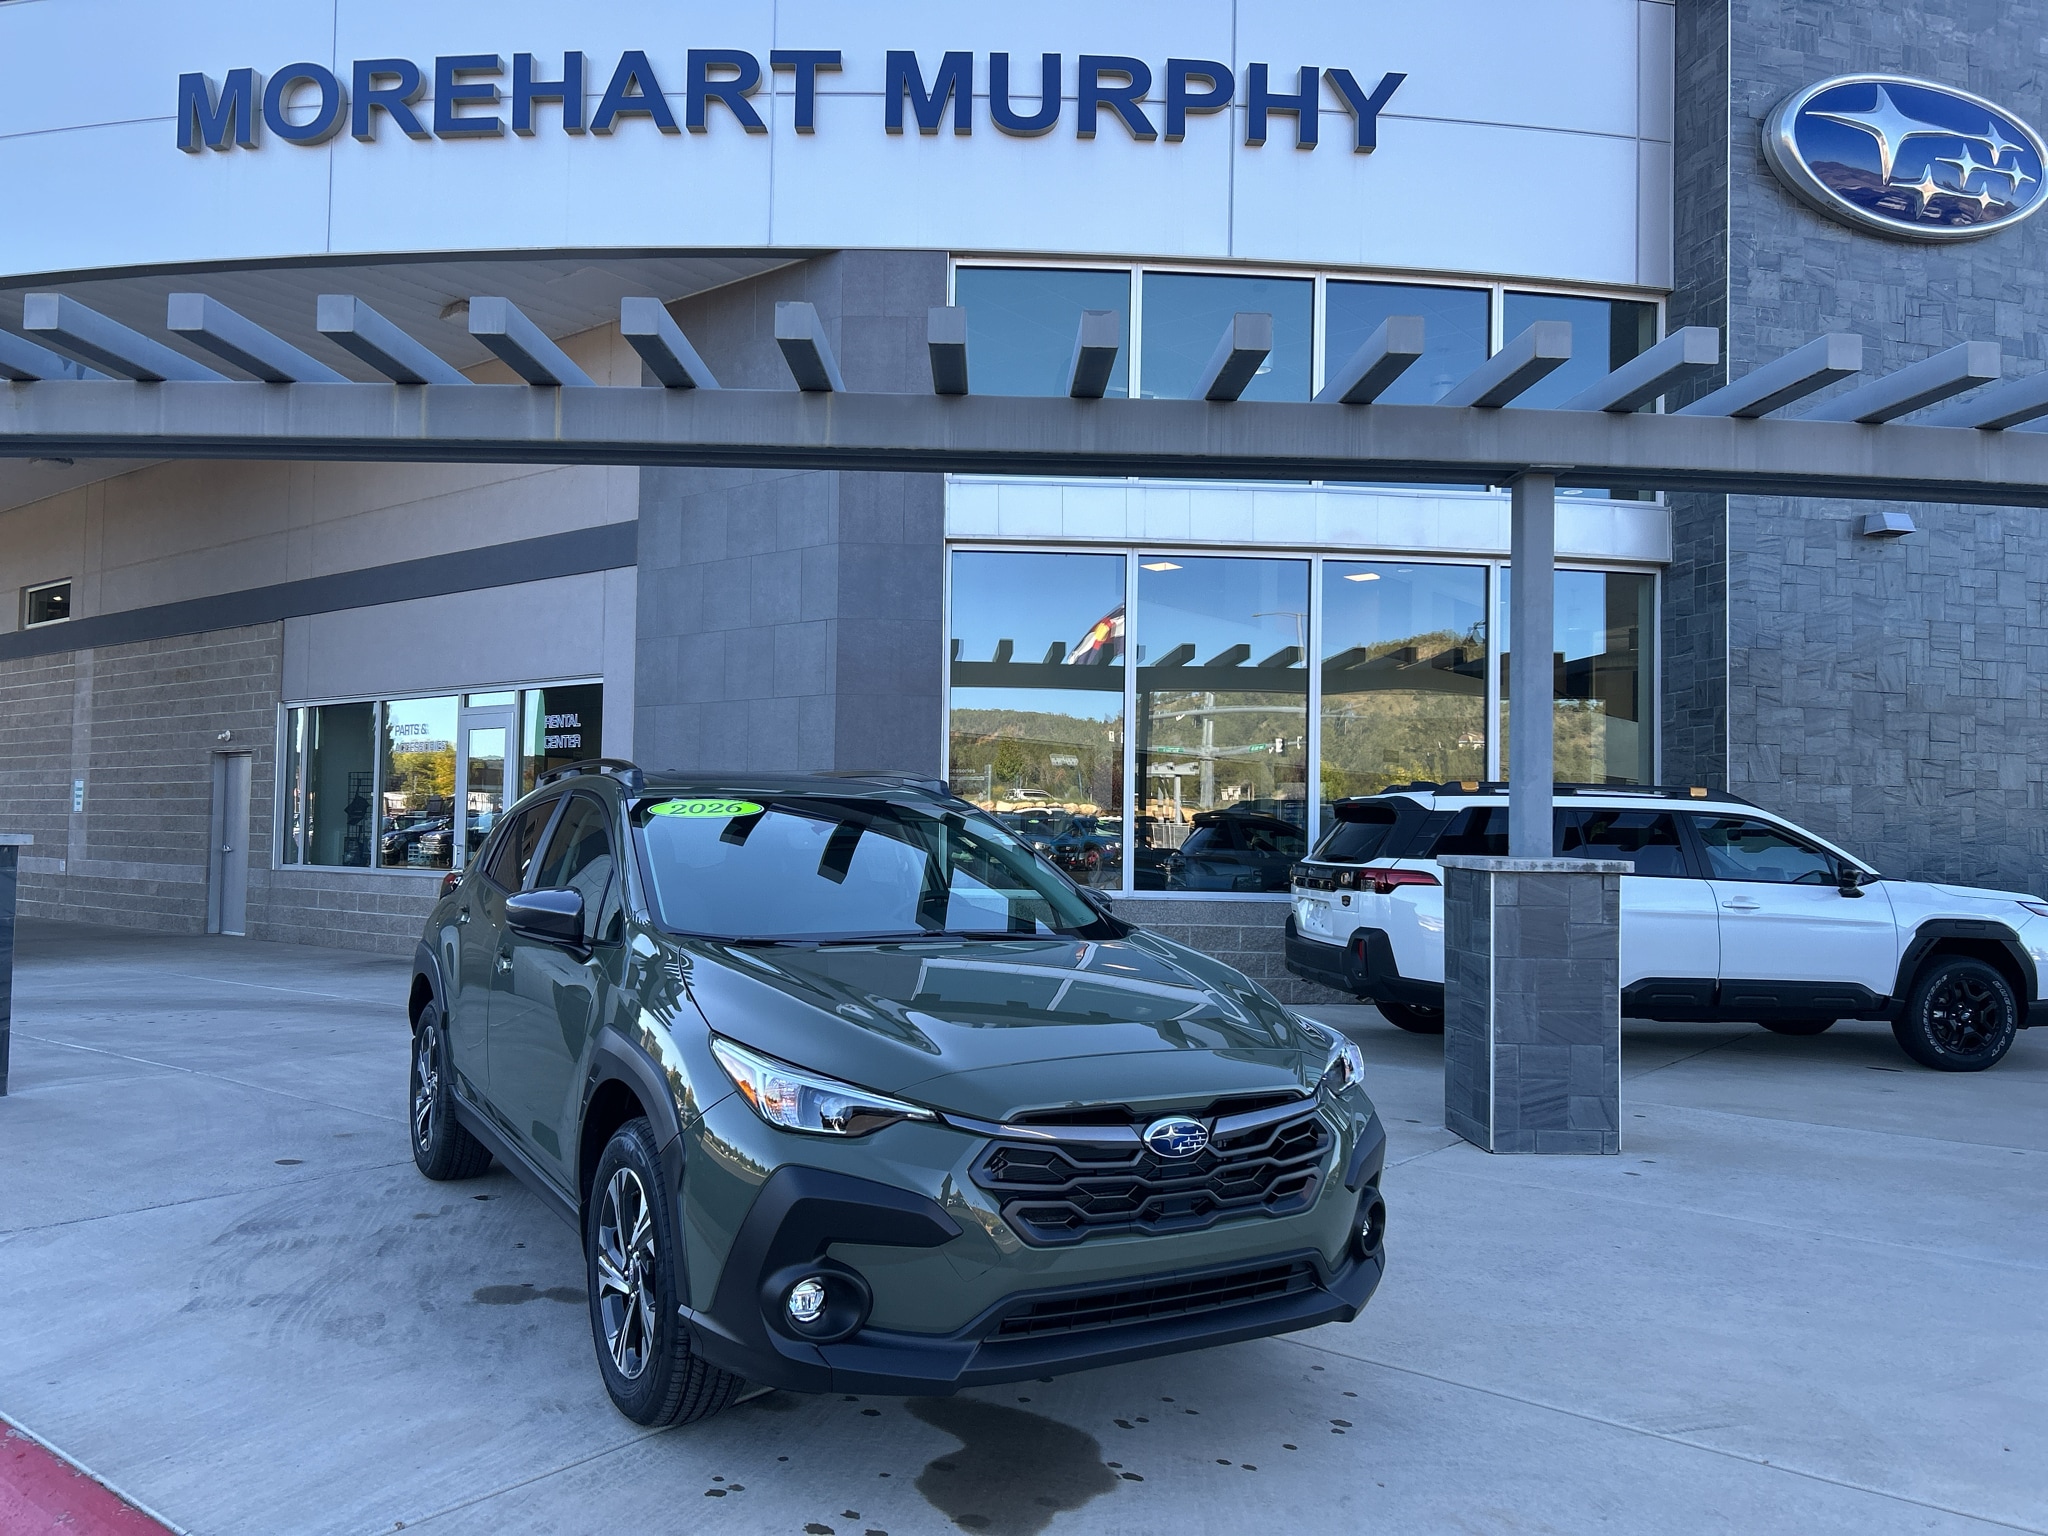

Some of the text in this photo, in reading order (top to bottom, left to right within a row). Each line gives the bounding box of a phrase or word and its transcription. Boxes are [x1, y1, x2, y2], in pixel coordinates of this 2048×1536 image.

[176, 48, 1408, 153] MOREHART MURPHY
[544, 713, 582, 729] RENTAL
[395, 723, 430, 737] PARTS &
[544, 733, 582, 749] CENTER
[669, 802, 743, 816] 2026
